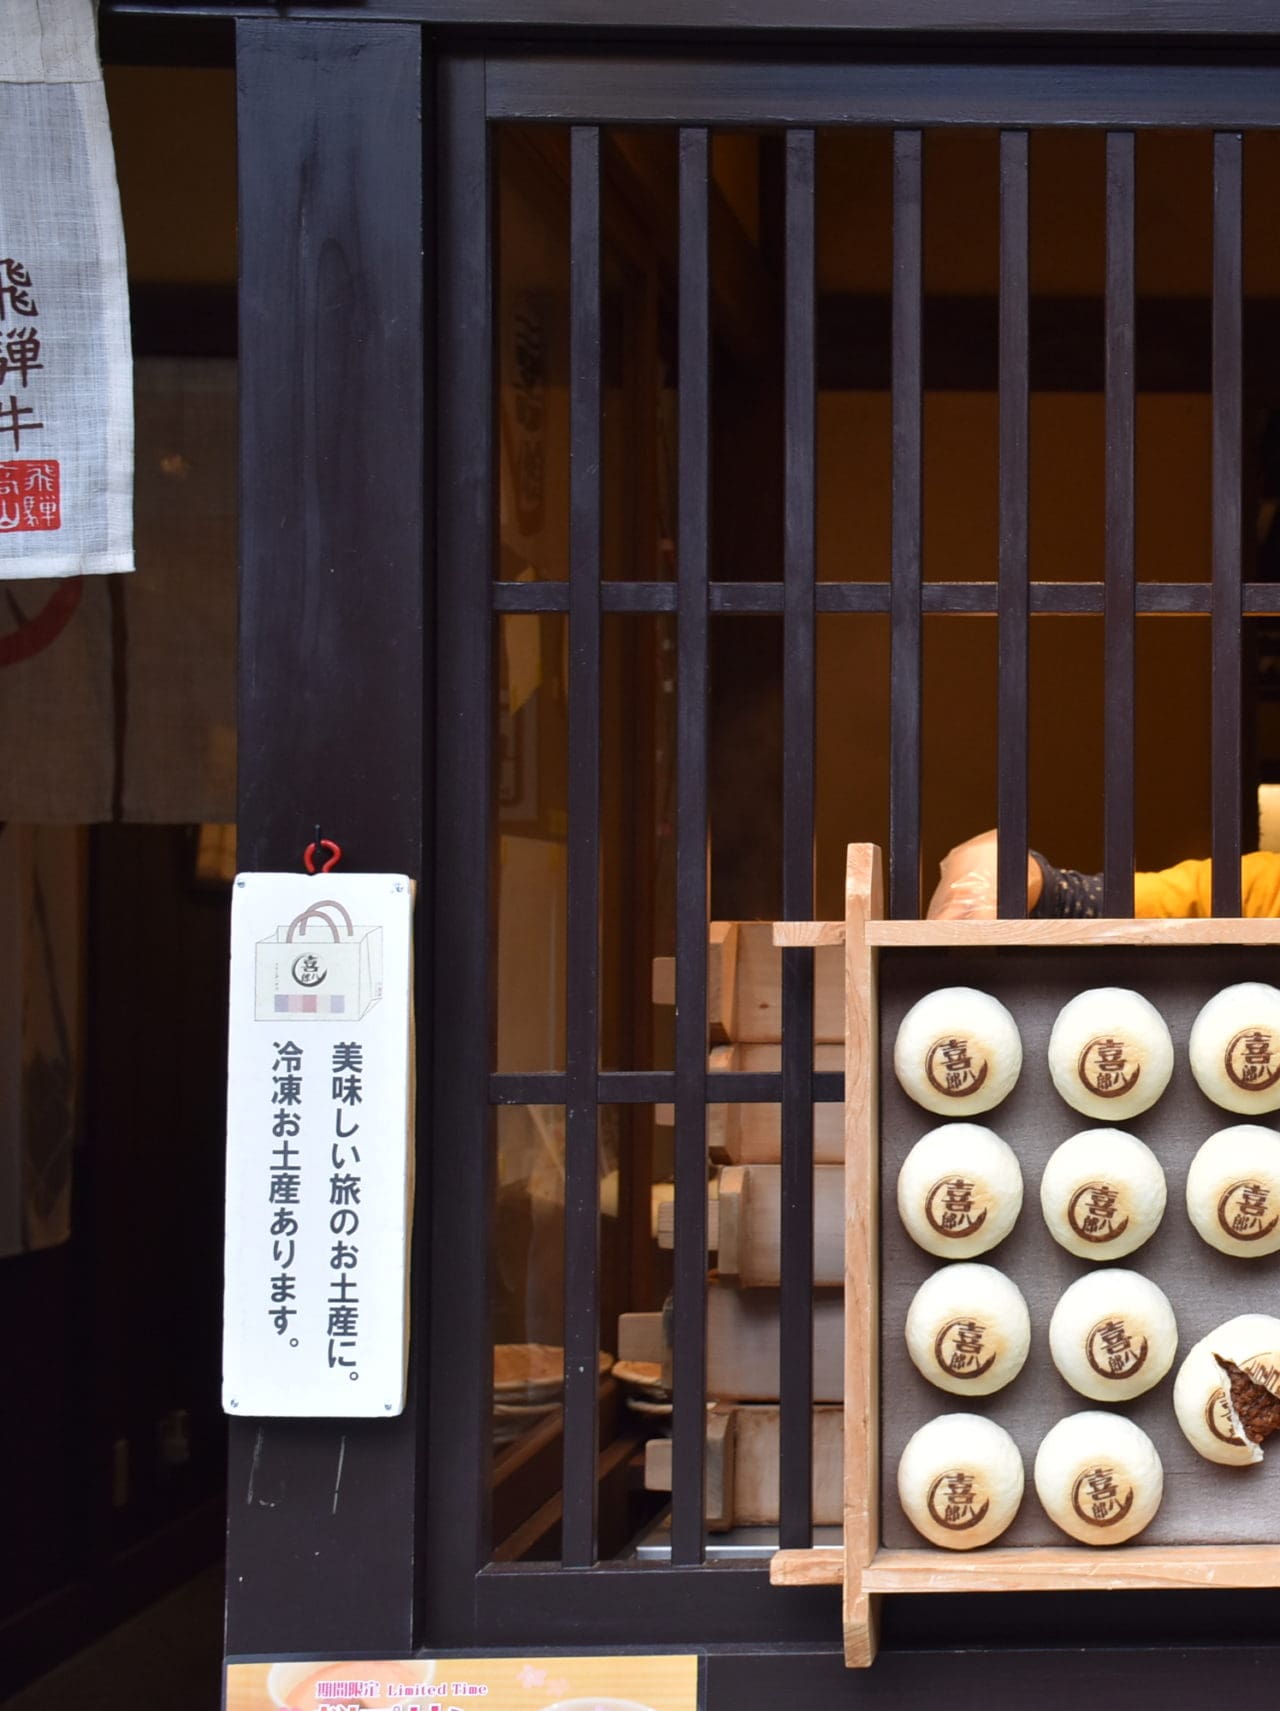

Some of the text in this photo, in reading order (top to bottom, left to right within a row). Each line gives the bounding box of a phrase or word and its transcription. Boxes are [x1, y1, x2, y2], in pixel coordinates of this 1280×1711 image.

[267, 1040, 304, 1349] 冷凍お土産あります。
[326, 1041, 364, 1381] 美味しい旅のお土産に。
[317, 1682, 487, 1697] 期間限定 Limited Time
